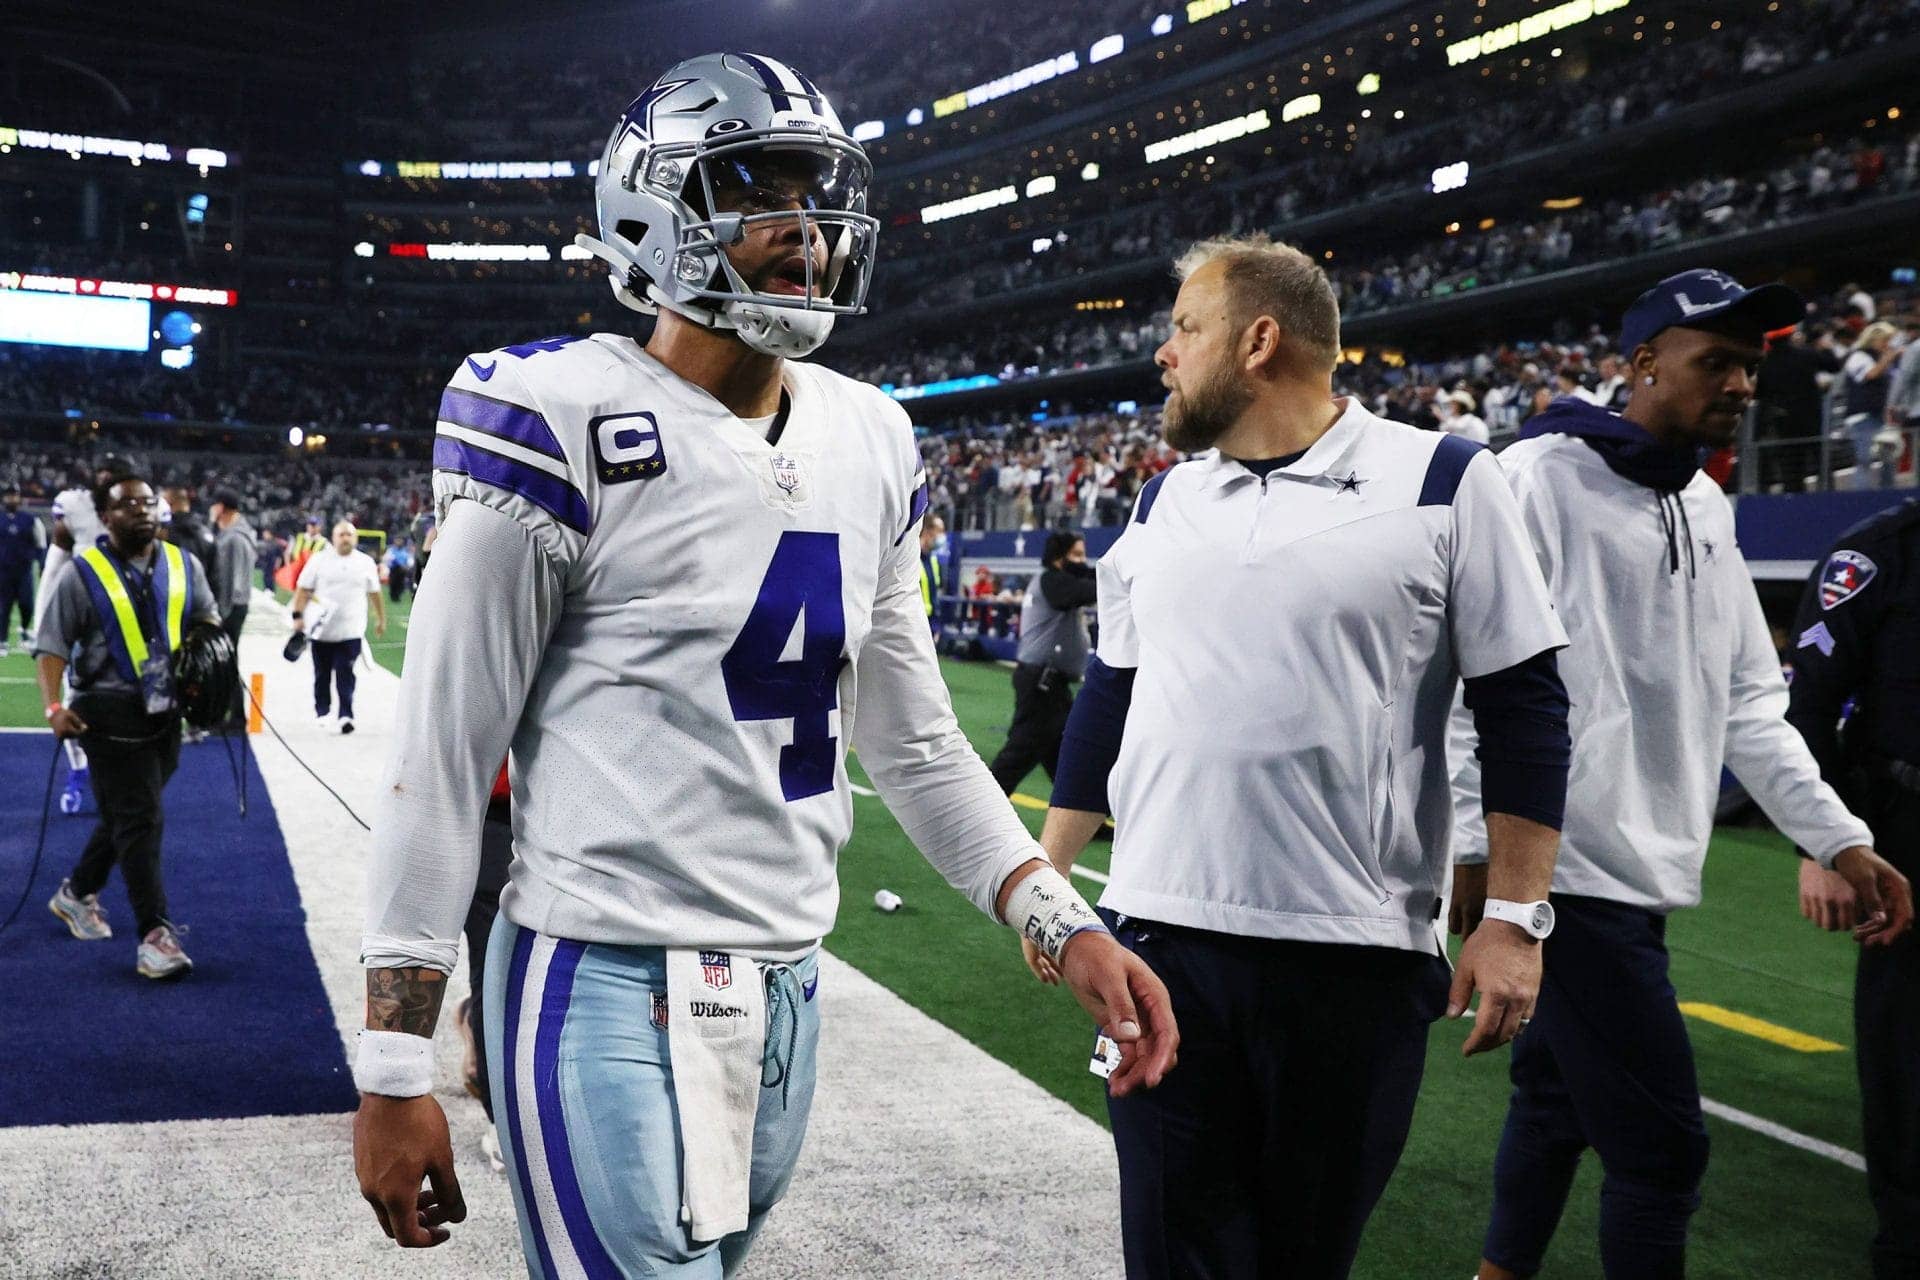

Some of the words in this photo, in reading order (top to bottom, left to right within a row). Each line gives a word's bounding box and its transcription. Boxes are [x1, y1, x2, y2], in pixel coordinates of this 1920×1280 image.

[597, 416, 658, 464] C
[721, 530, 846, 802] 4
[702, 965, 729, 987] NFL
[690, 1001, 742, 1018] Wilson
